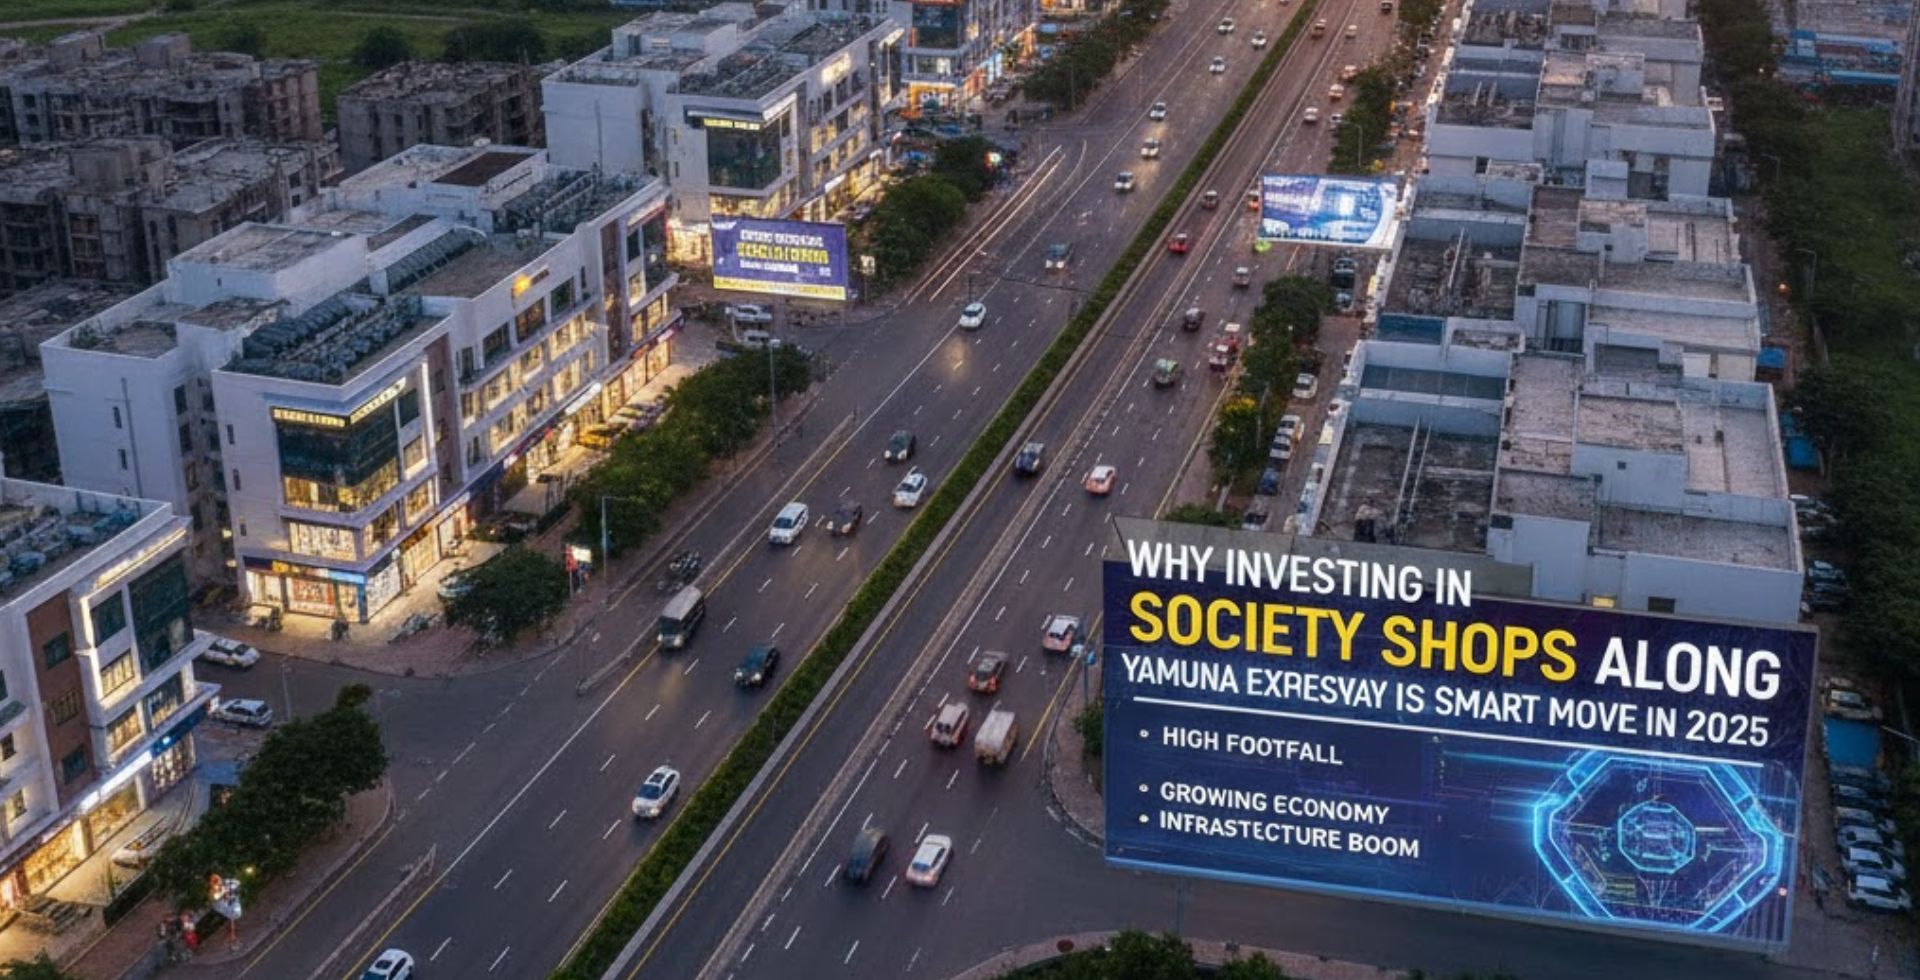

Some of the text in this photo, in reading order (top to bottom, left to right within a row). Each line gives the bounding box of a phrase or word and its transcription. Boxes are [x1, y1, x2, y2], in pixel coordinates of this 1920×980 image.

[1128, 540, 1472, 607] WHY INVESTING IN
[1129, 592, 1782, 701] SOCIETY SHOPS ALONG
[1122, 653, 1239, 694] YAMUNA
[1396, 682, 1425, 714] IS
[1435, 685, 1541, 724] SMART
[1548, 697, 1638, 735] MOVE
[1646, 706, 1678, 738] IN
[1685, 710, 1770, 748] 2025
[1162, 726, 1343, 765] HIGH FOOTFALL
[1160, 782, 1390, 825] GROWING ECONOMY
[1348, 832, 1420, 858] BOOM
